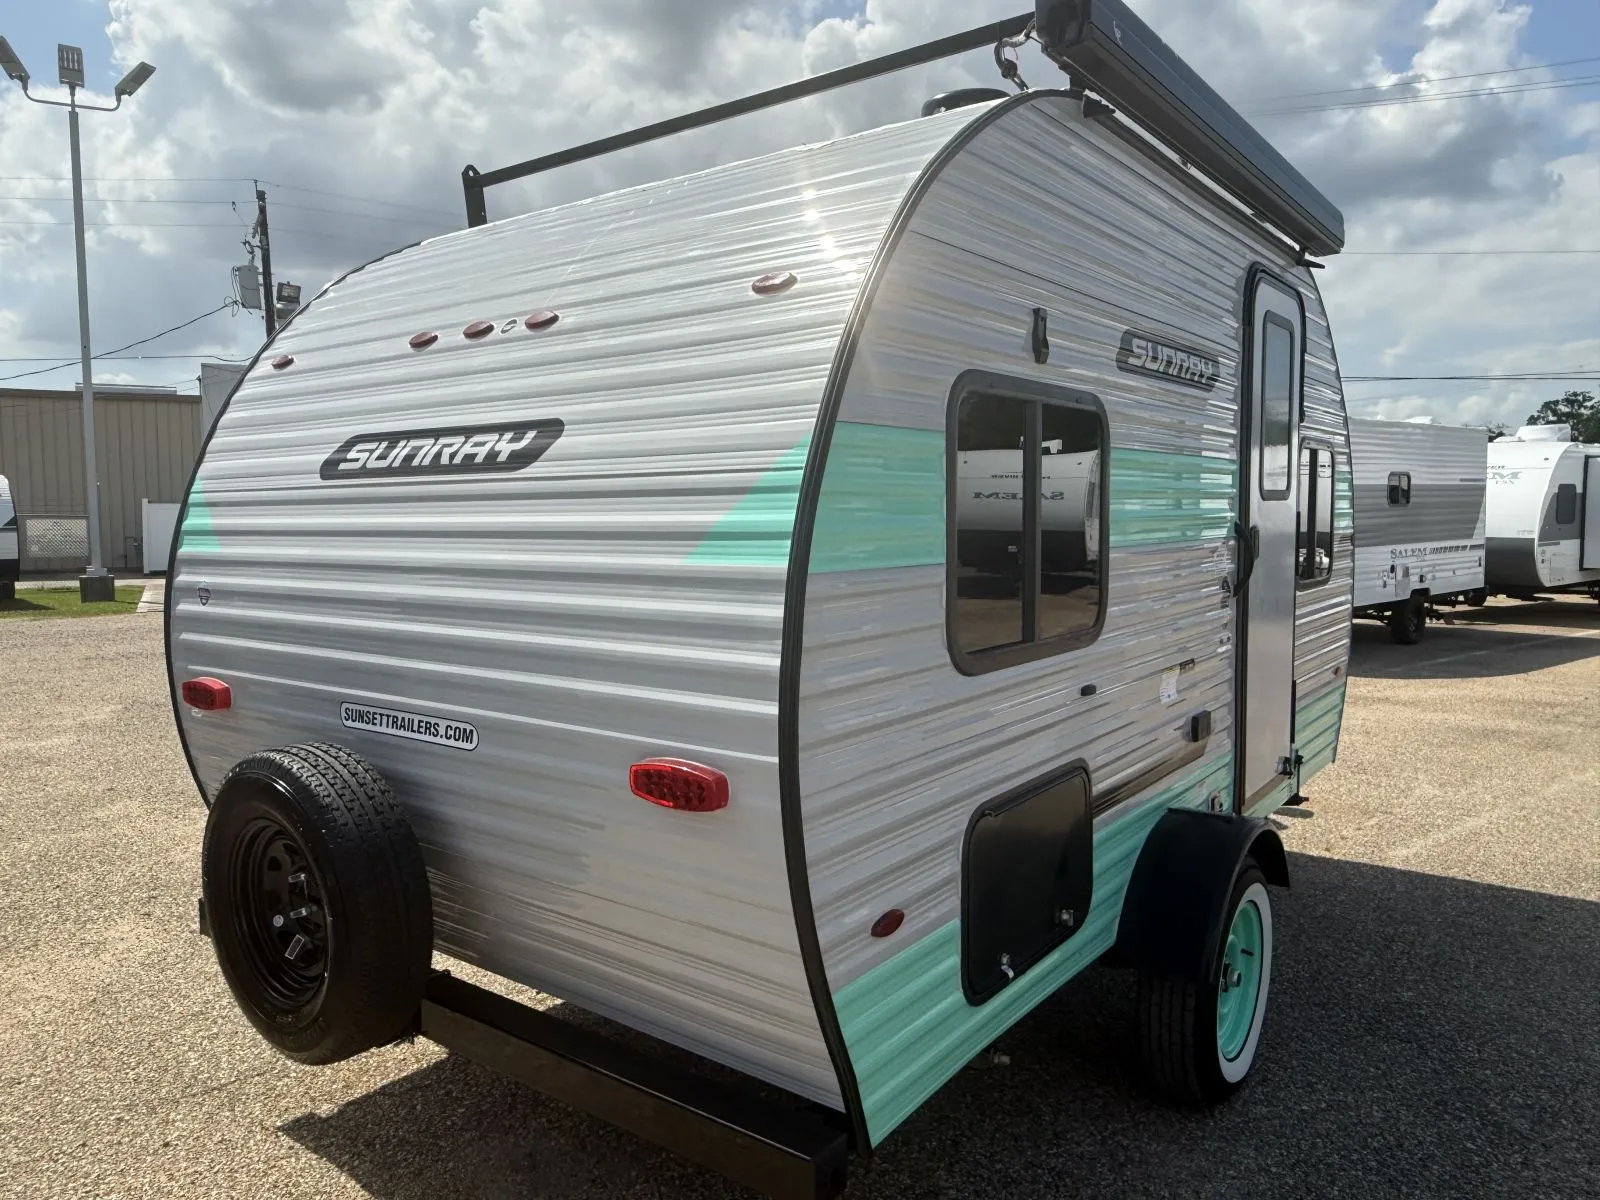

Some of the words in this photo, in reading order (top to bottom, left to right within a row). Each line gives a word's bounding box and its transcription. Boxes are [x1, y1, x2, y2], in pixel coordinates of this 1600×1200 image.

[1127, 337, 1213, 383] SUNRAY
[337, 430, 538, 471] SUNRAY
[1390, 547, 1427, 559] SALEM
[344, 707, 474, 744] SUNSETTRAILERS.COM
